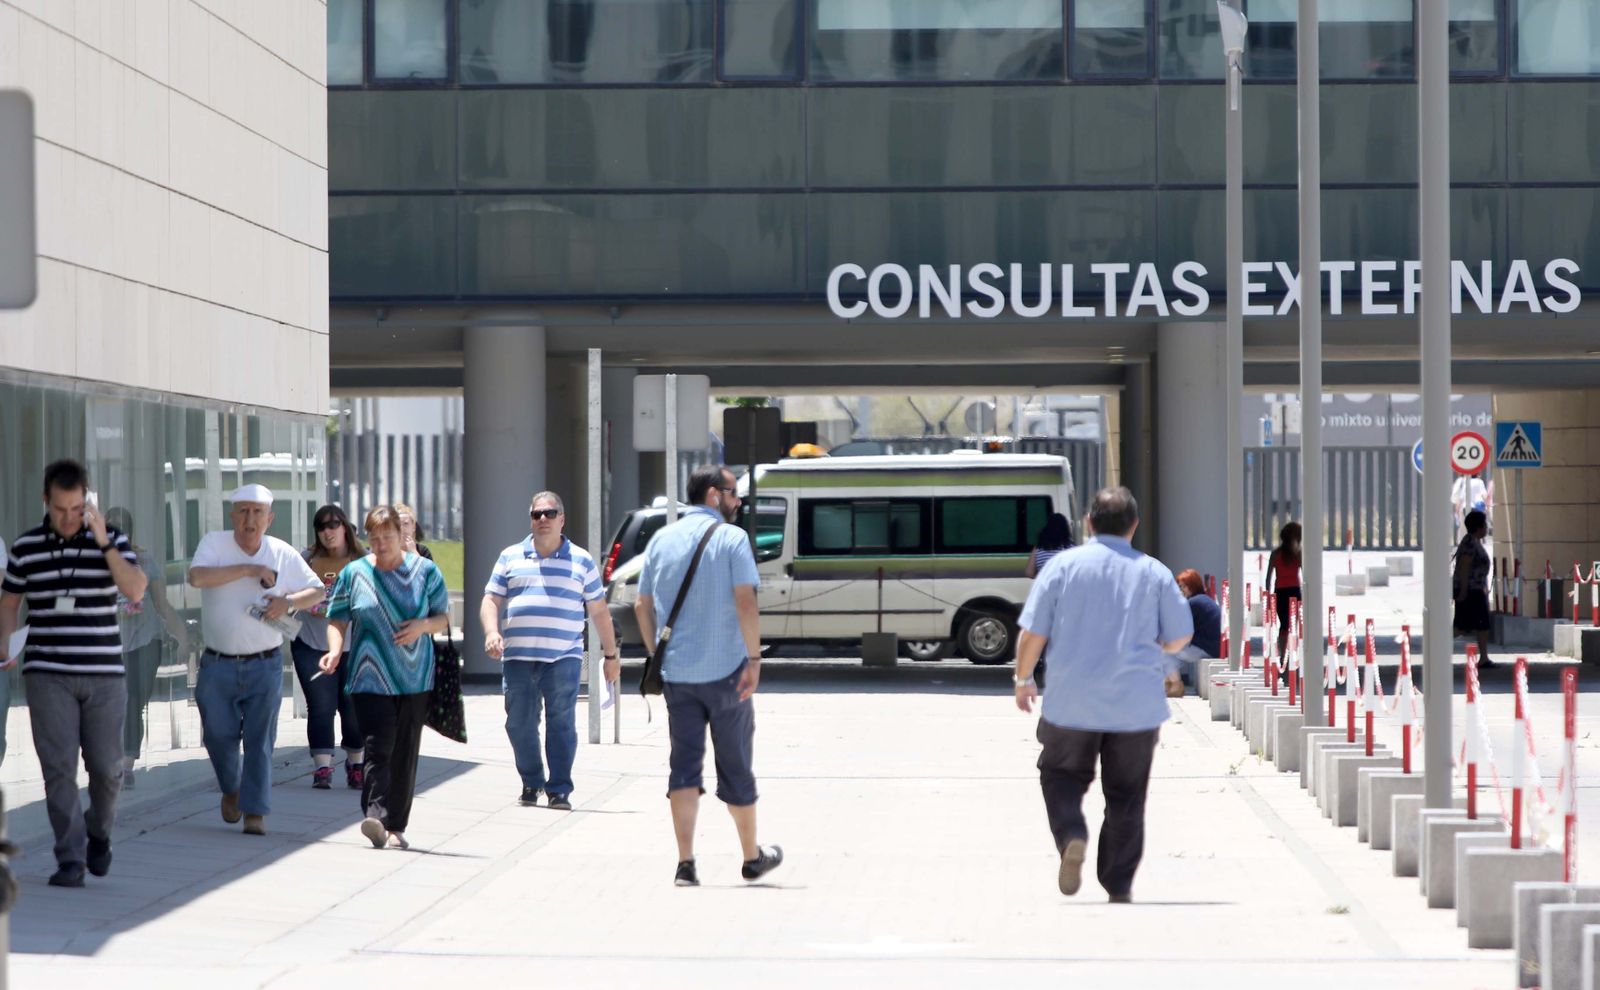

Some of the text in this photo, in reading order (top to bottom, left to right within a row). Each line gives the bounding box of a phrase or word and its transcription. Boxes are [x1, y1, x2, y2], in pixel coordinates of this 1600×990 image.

[827, 261, 1210, 318] CONSULTAS
[1329, 412, 1372, 427] mixto
[1457, 446, 1480, 460] 20
